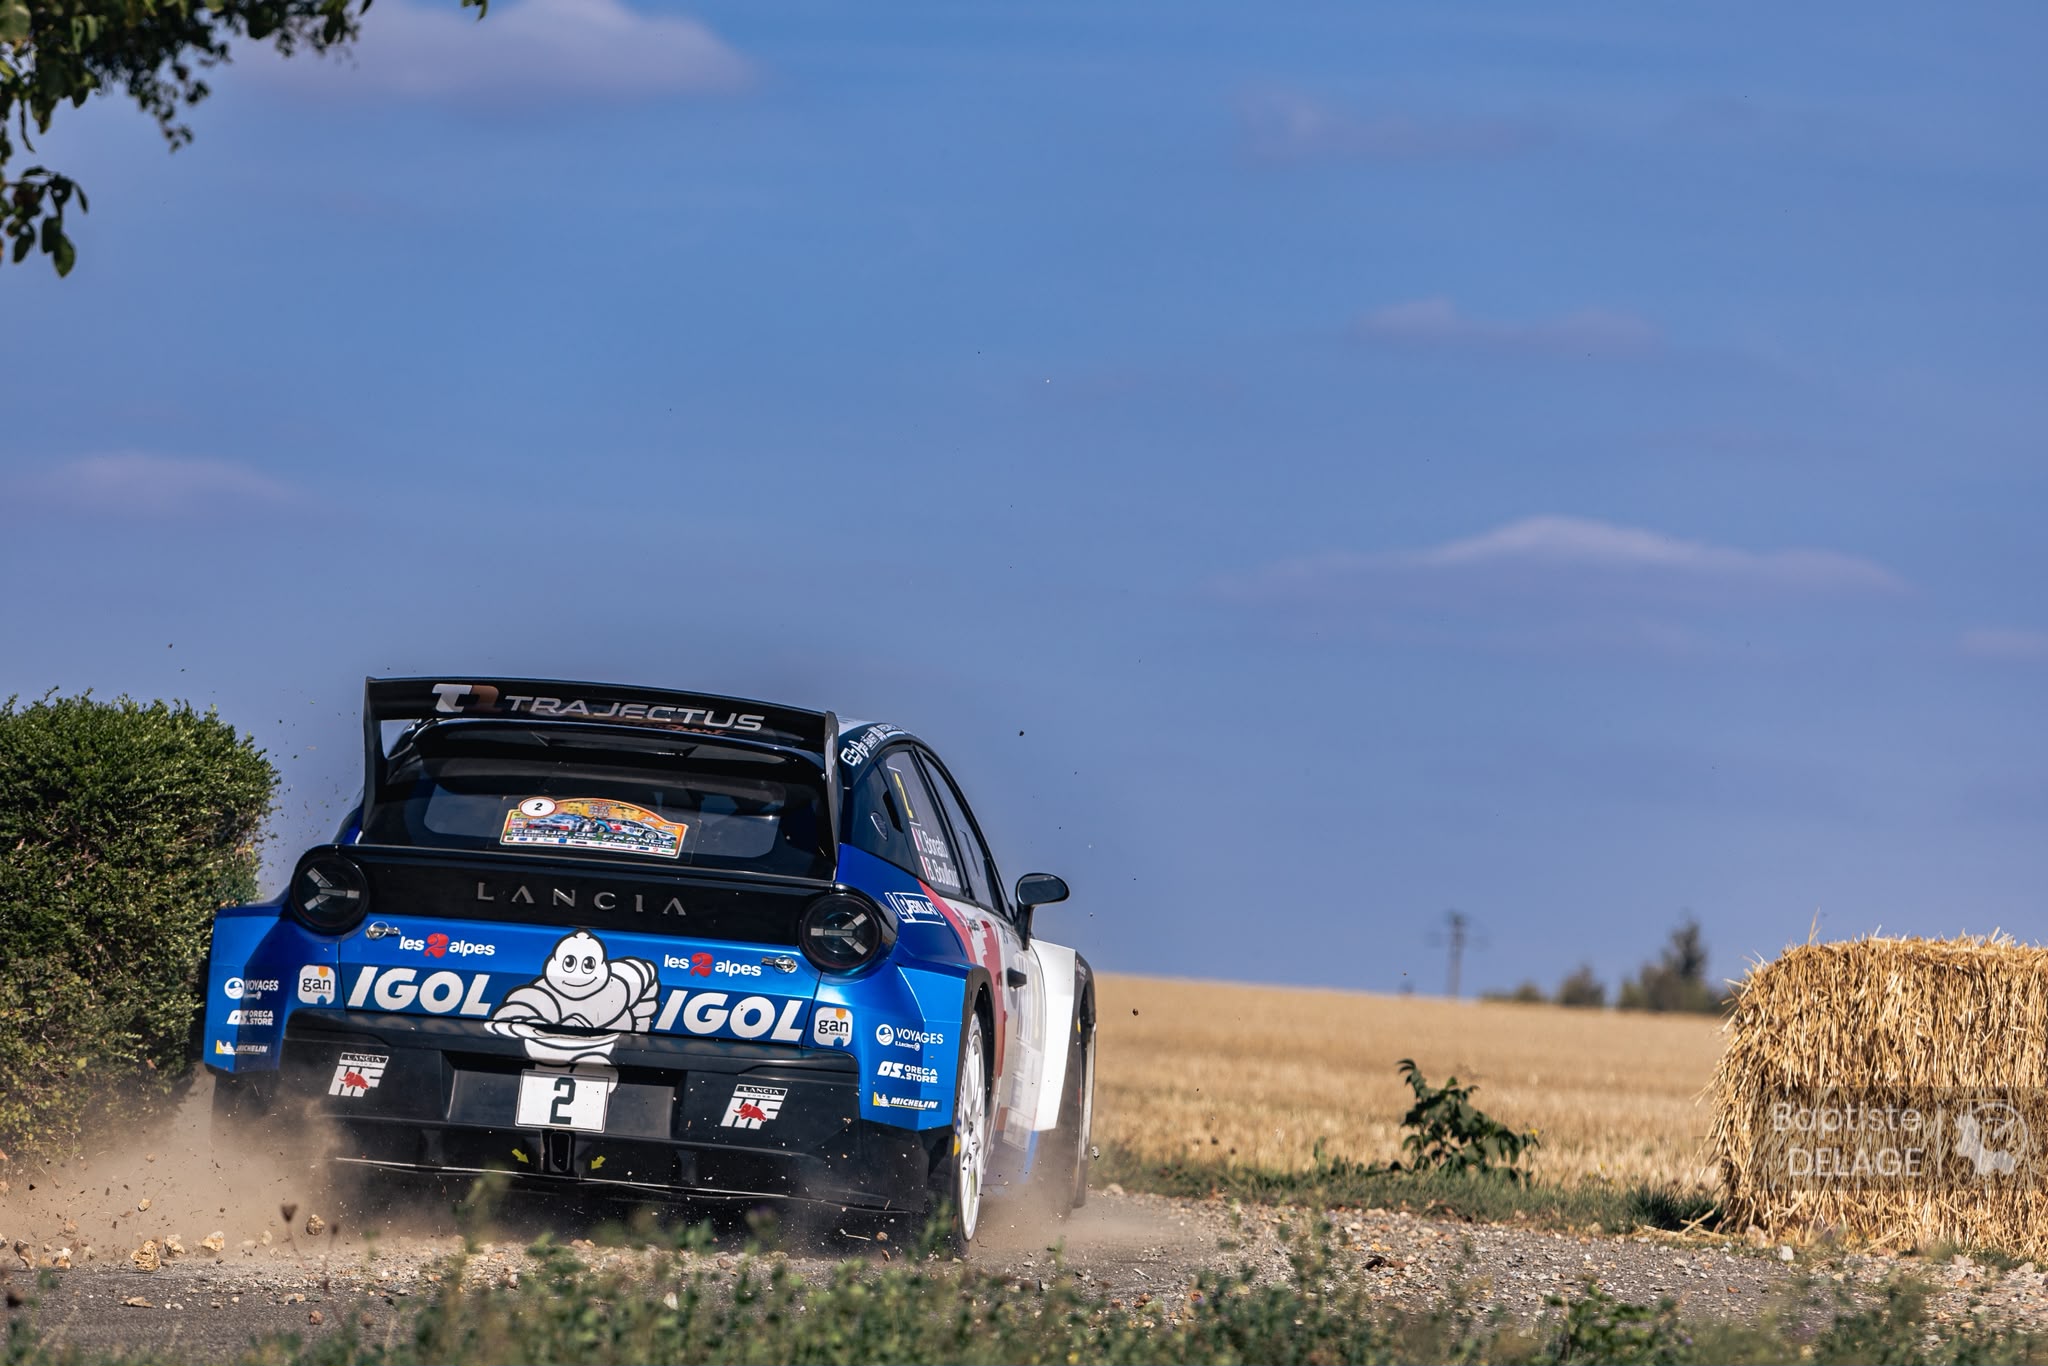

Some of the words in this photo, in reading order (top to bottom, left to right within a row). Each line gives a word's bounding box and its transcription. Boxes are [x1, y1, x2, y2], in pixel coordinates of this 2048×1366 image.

[505, 695, 764, 731] TRAJECTUS
[534, 802, 542, 811] 2
[477, 882, 687, 916] LANCIA
[399, 936, 424, 951] les
[424, 933, 449, 959] 2
[449, 941, 495, 957] alpes
[664, 954, 689, 970] les
[690, 953, 713, 977] 2
[715, 960, 762, 977] alpes
[245, 979, 279, 991] VOYAGES
[302, 978, 331, 992] gan
[347, 966, 491, 1016] IGOL
[249, 1010, 273, 1018] ORECA
[655, 990, 803, 1042] IGOL
[818, 1020, 849, 1034] gan
[896, 1027, 944, 1045] VOYAGES
[236, 1044, 268, 1053] MICHELIN
[904, 1065, 938, 1076] ORECA
[743, 1086, 779, 1095] LANCIA
[549, 1077, 576, 1124] 2
[891, 1097, 938, 1109] MICHELIN
